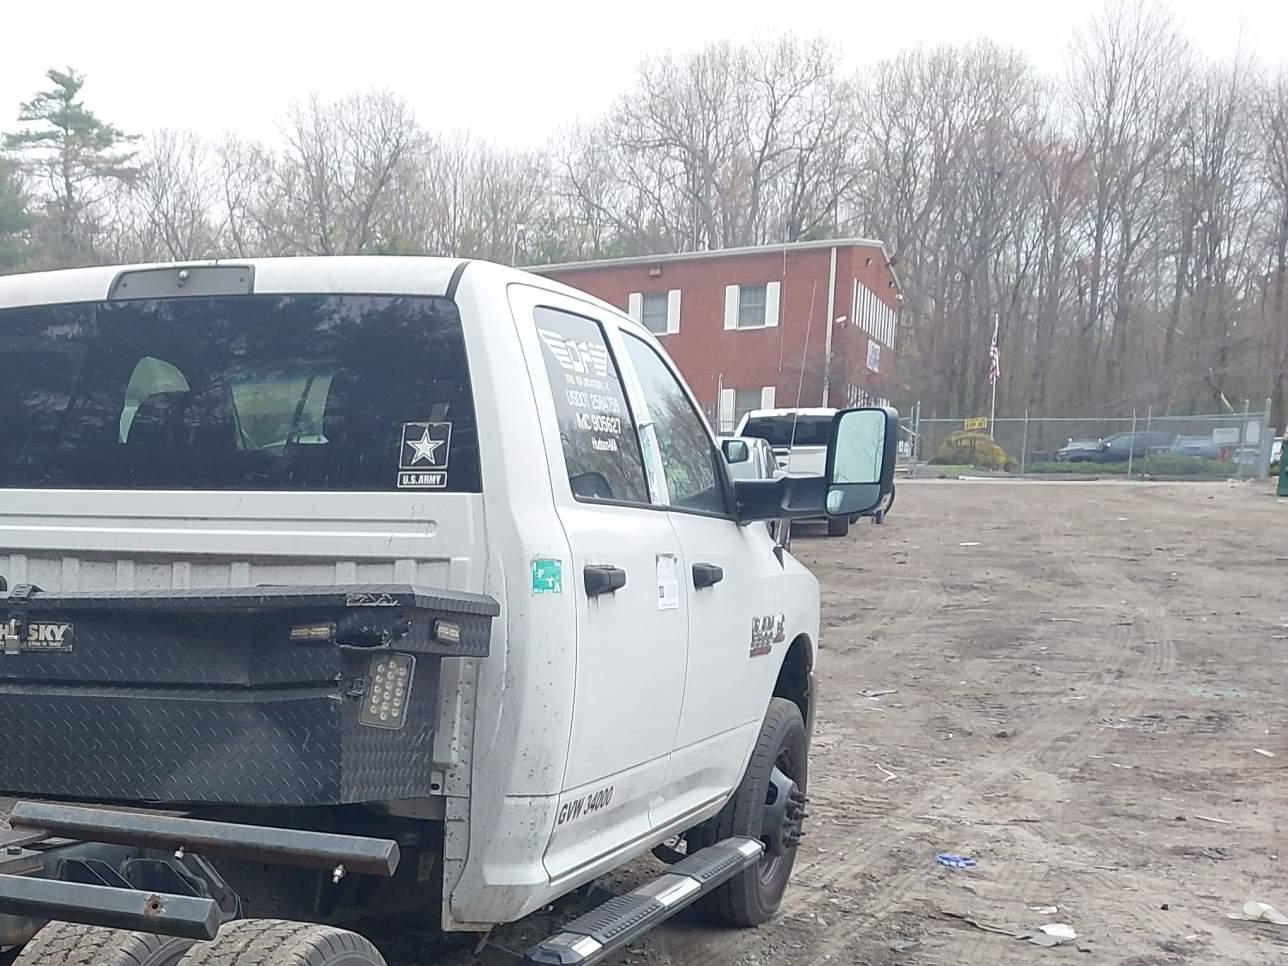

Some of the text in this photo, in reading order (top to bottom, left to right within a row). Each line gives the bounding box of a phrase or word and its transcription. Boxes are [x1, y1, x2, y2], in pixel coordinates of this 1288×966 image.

[576, 412, 621, 434] MC 905627
[558, 785, 614, 825] GVW 34000
